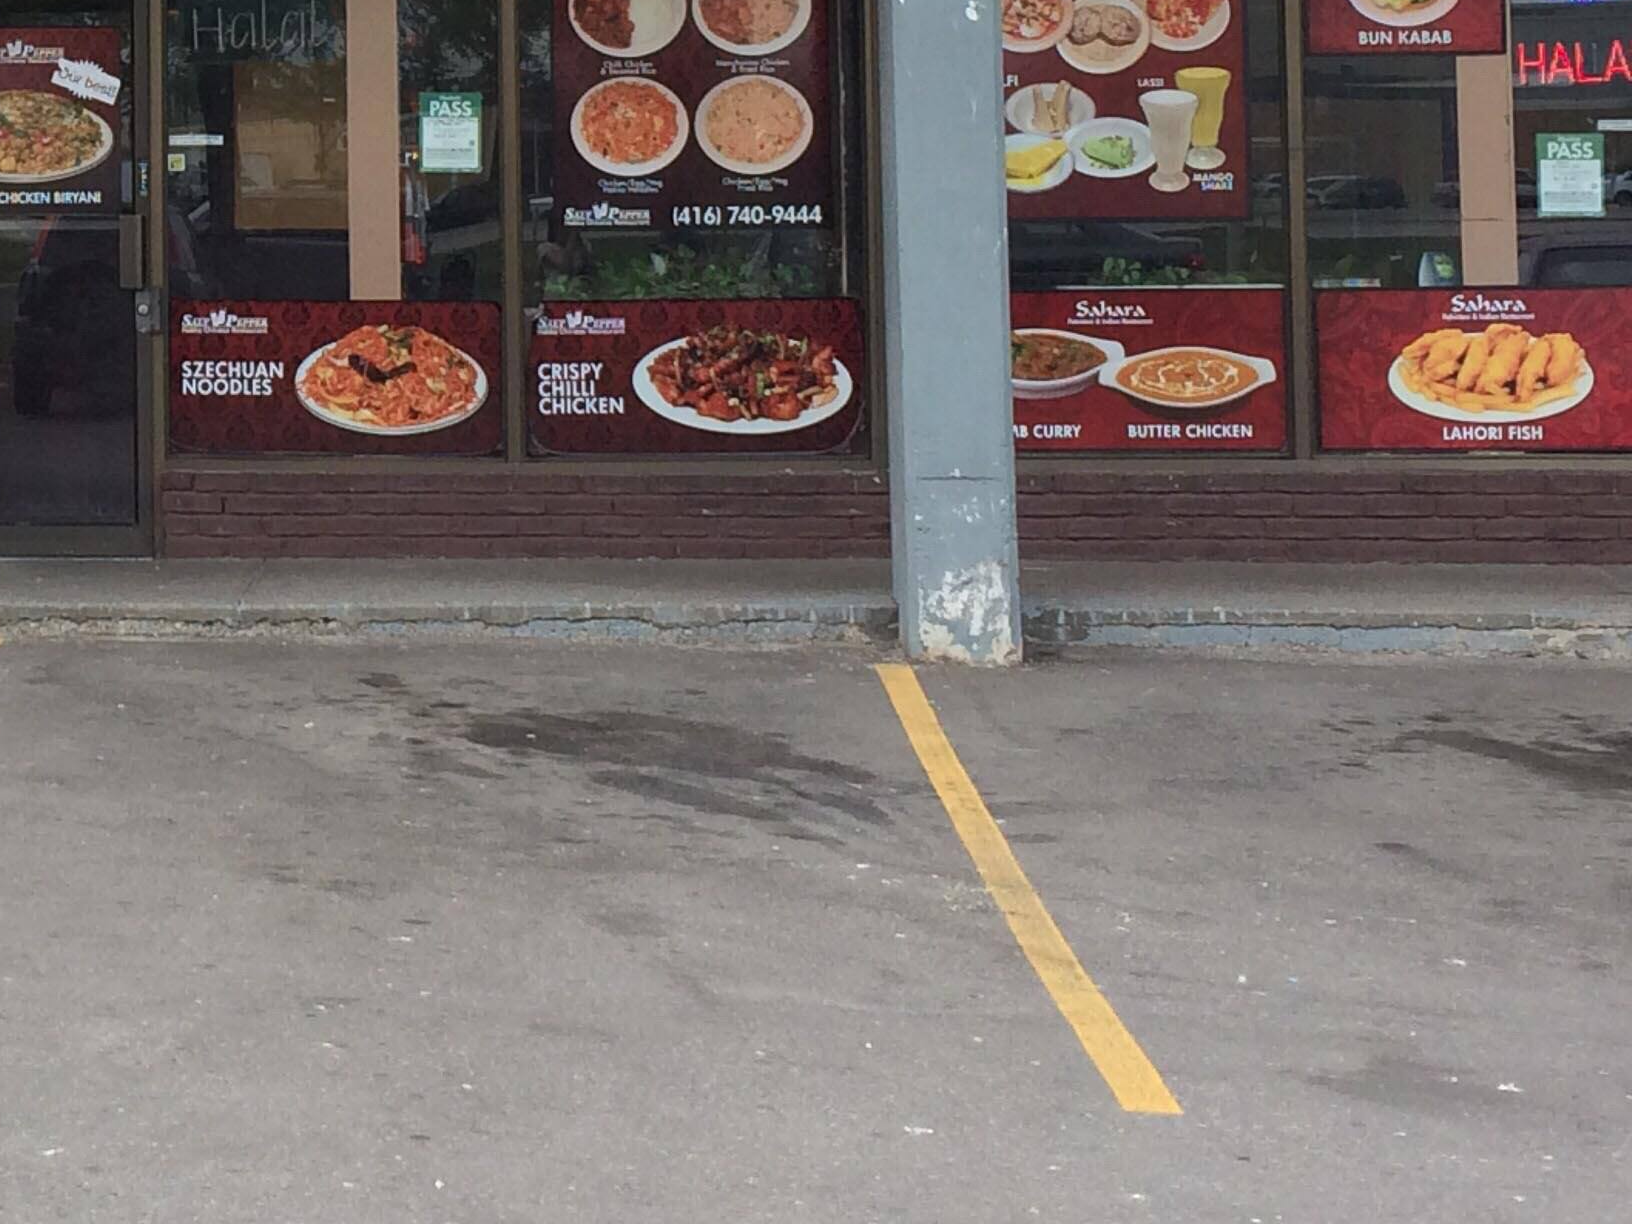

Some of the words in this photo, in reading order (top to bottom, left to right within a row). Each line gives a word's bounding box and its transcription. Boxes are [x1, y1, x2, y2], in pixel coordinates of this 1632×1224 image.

[1358, 30, 1393, 45] BUN
[1398, 30, 1452, 45] KABAB
[430, 100, 473, 116] PASS
[1547, 142, 1594, 159] PASS
[54, 191, 102, 204] BIRYANI
[673, 206, 721, 226] (416)
[727, 205, 822, 224] 740-9444
[1076, 300, 1146, 317] Sahara
[1451, 294, 1526, 312] Sahara
[182, 361, 284, 378] SZECHUAN
[537, 363, 603, 380] CRISPY
[182, 378, 272, 395] NOODLES
[538, 380, 595, 397] CHILLI
[539, 397, 624, 414] CHICKEN
[1033, 425, 1082, 438] CURRY
[1128, 424, 1181, 438] BUTTER
[1186, 424, 1253, 438] CHICKEN
[1443, 426, 1503, 440] LAHORI
[1508, 425, 1543, 440] FISH
